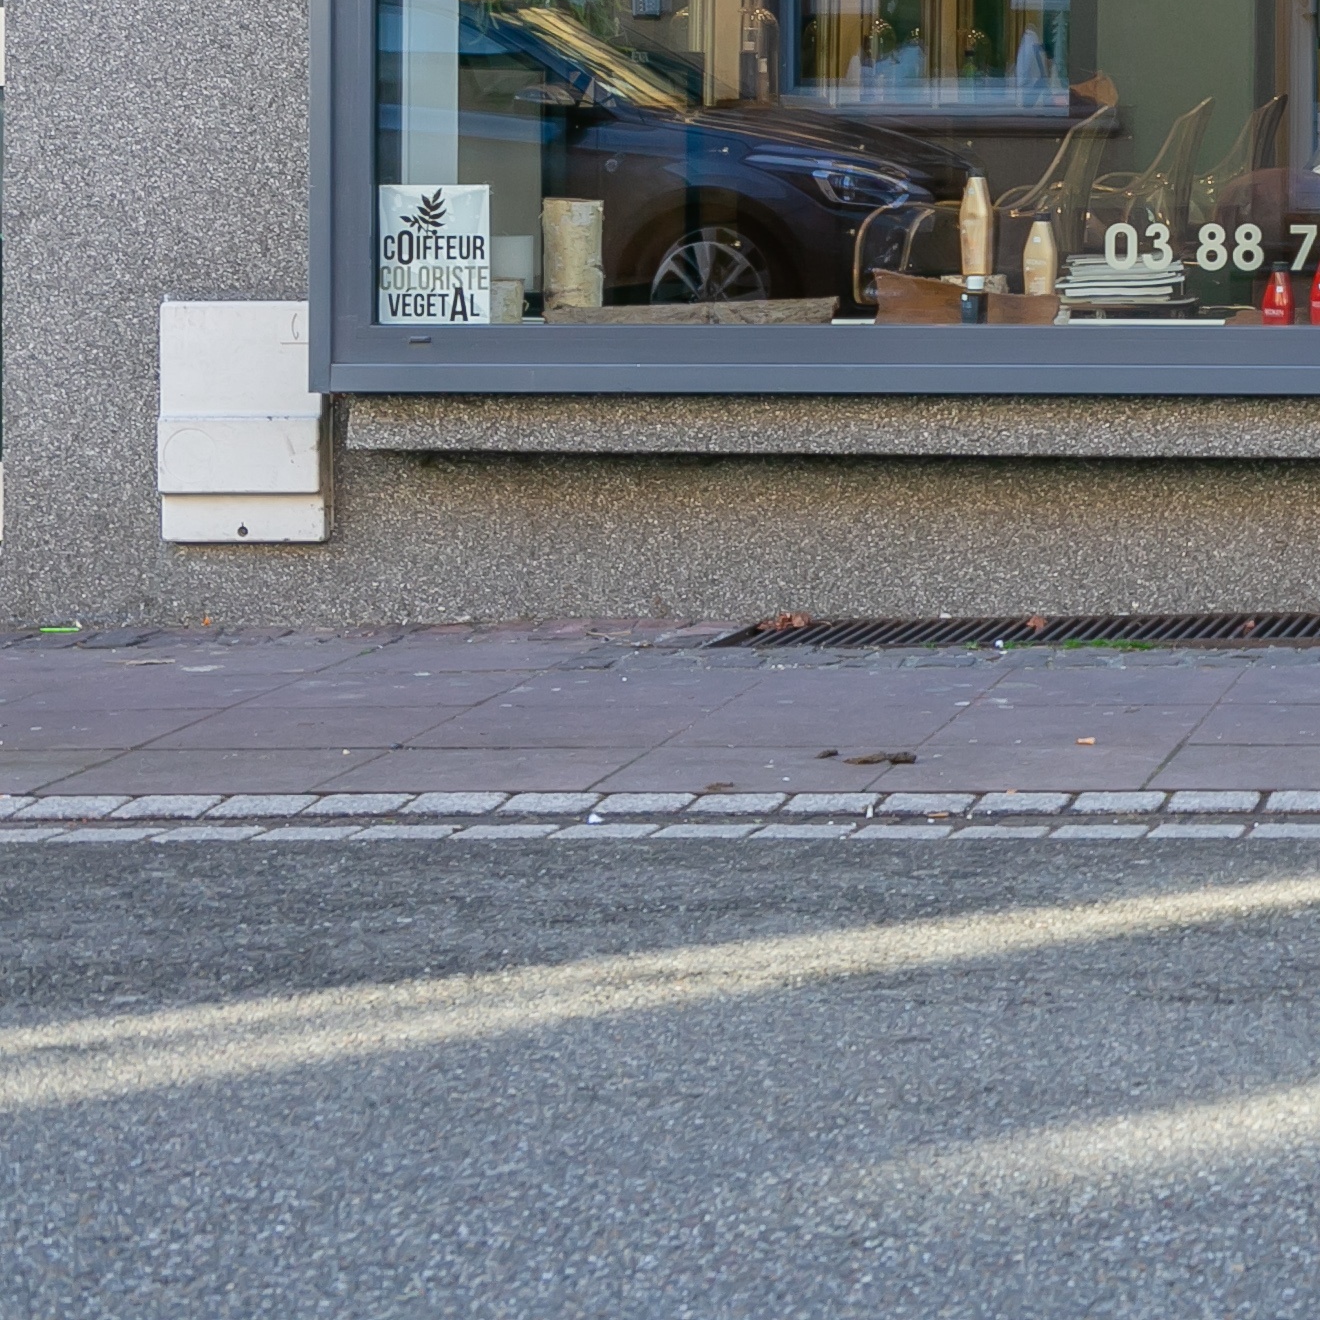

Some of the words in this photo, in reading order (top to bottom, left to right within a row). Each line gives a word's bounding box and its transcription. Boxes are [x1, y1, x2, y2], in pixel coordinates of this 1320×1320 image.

[383, 230, 485, 265] COIFFEUR
[1104, 222, 1174, 272] 03
[1196, 222, 1265, 272] 88
[380, 265, 489, 290] COLORISTE
[388, 287, 480, 322] VÉGÉTAL
